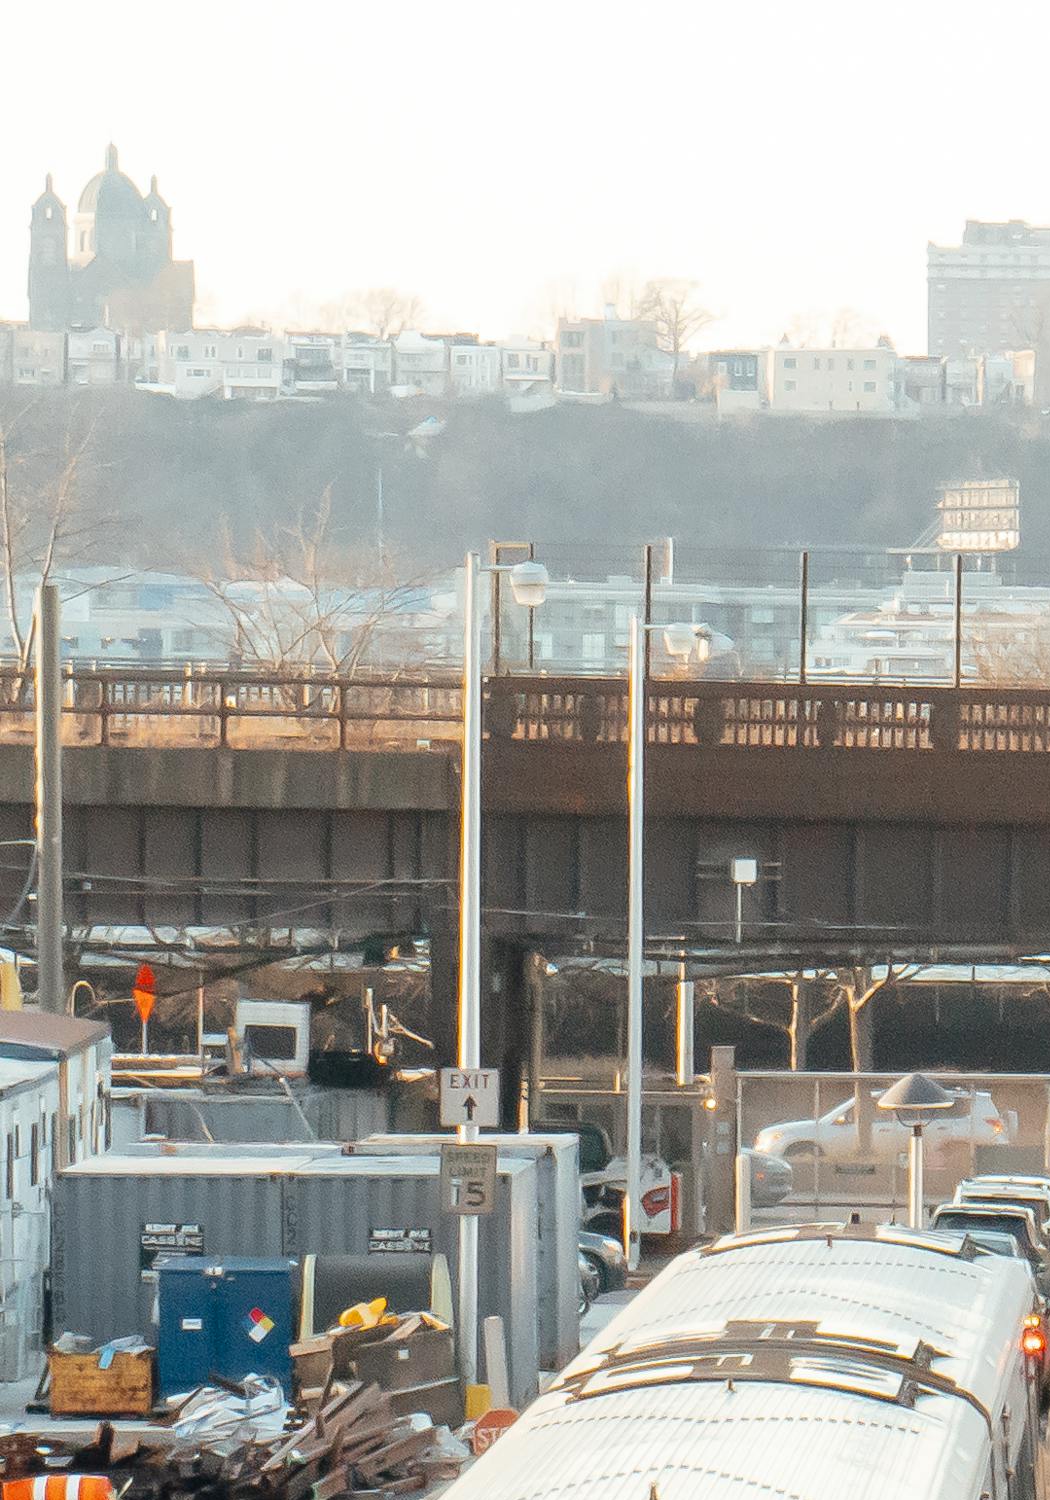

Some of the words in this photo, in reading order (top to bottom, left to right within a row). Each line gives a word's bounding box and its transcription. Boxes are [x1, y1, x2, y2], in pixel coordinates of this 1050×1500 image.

[450, 1074, 489, 1089] EXIT
[447, 1152, 490, 1163] SPEED
[450, 1166, 487, 1177] LIMIT
[450, 1179, 486, 1207] 15
